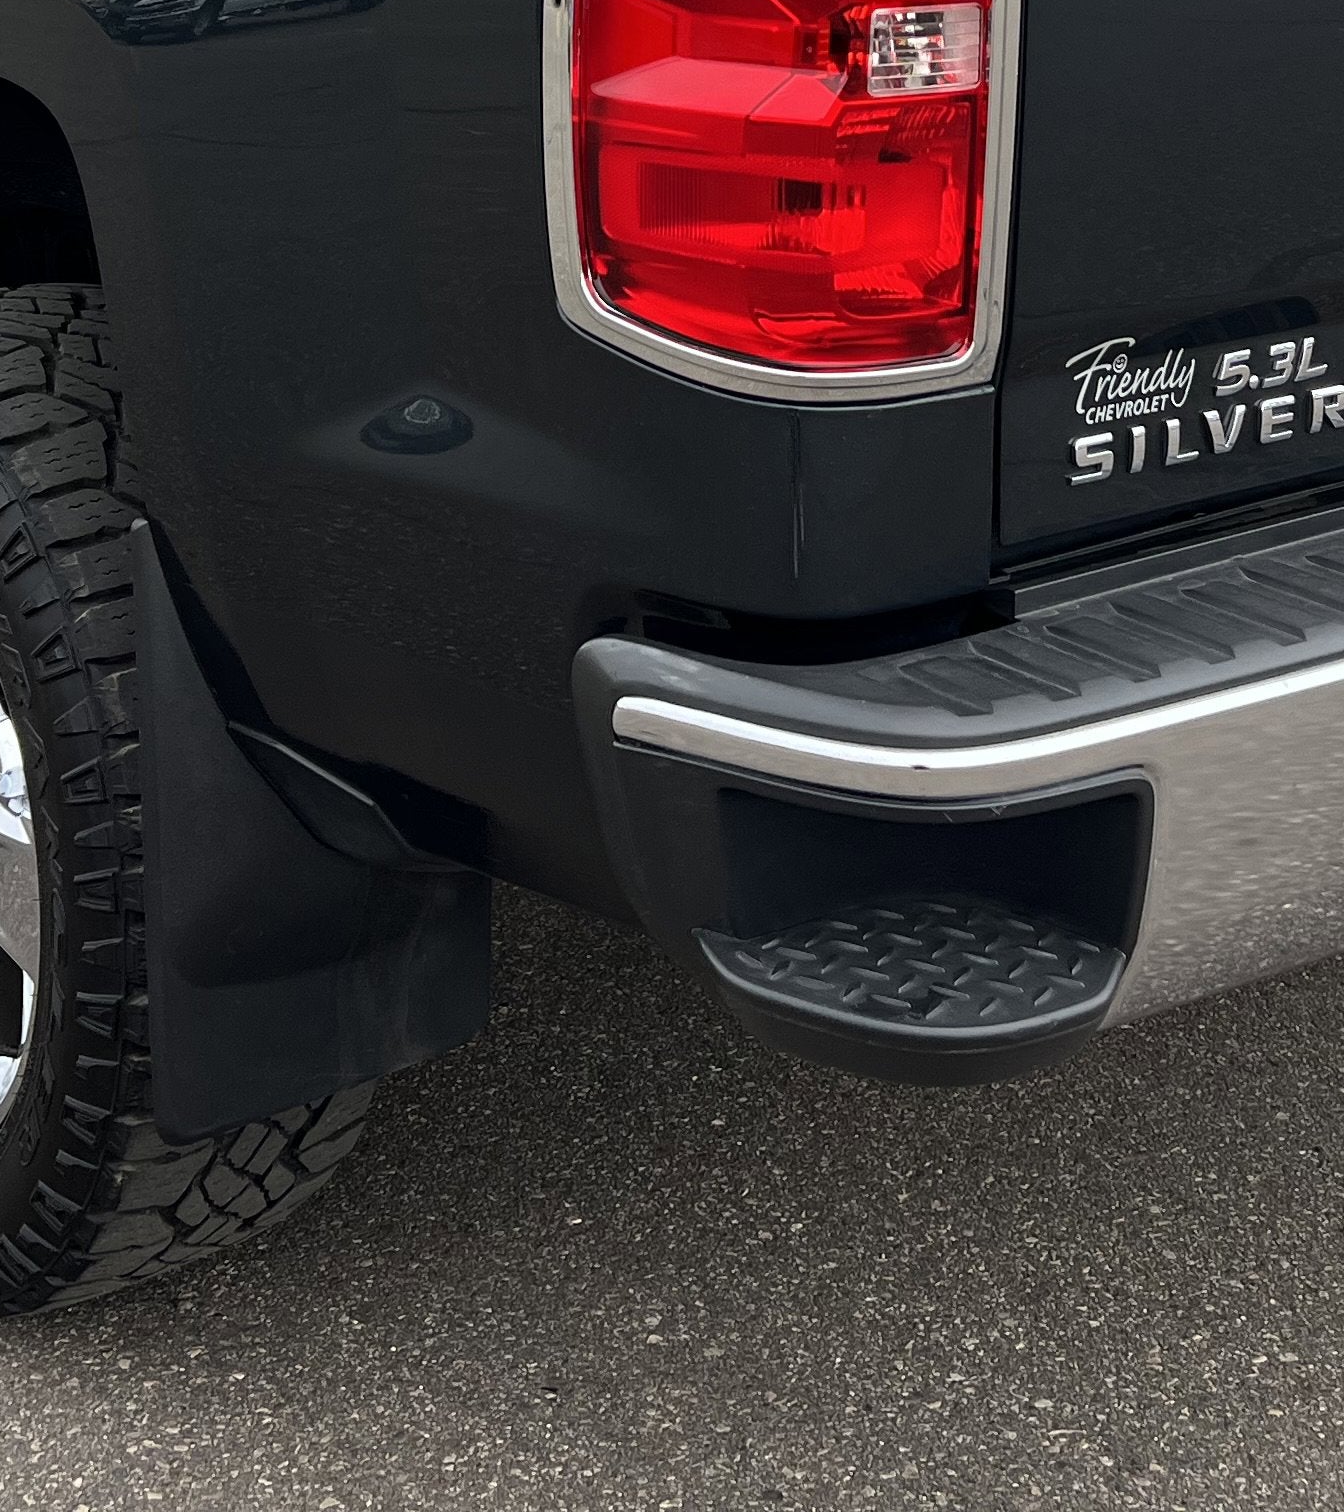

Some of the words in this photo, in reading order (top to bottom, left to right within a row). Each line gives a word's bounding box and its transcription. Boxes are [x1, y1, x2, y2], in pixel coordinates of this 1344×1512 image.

[1065, 337, 1195, 414] Friendly
[1212, 336, 1328, 397] 5.3L
[1085, 393, 1170, 425] CHEVROLET
